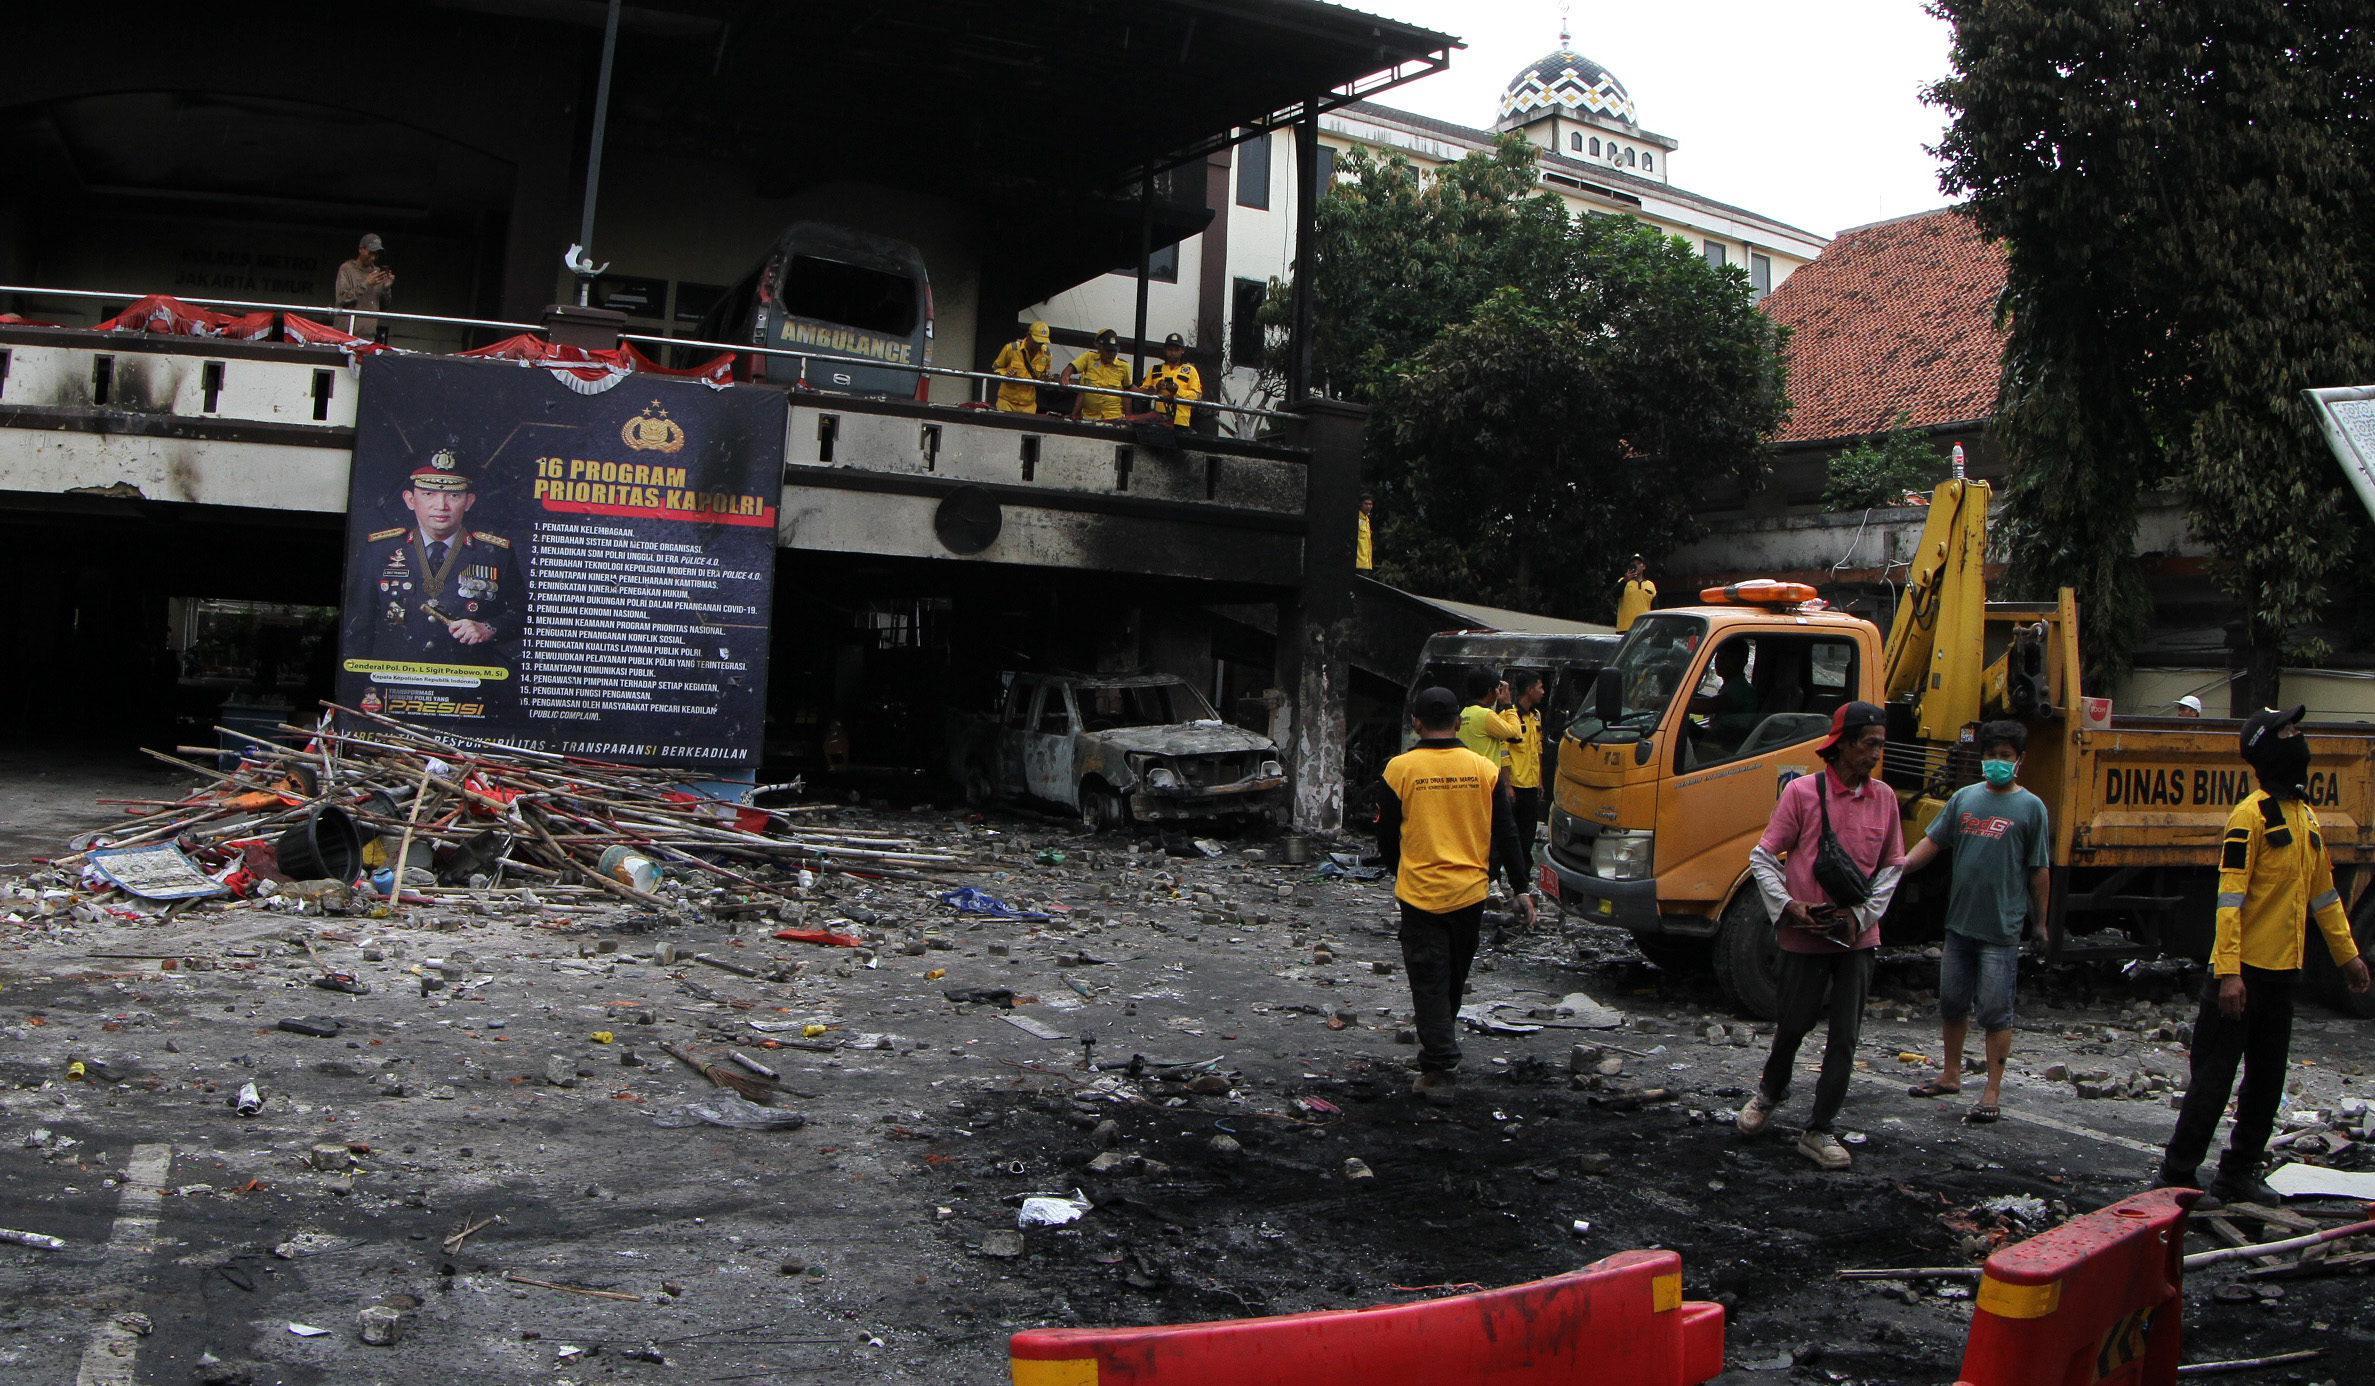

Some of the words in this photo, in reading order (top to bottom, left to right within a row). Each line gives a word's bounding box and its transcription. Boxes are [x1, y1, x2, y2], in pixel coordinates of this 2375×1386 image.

[181, 248, 251, 266] POLRES
[256, 254, 317, 271] METRO
[175, 271, 257, 291] JAKARTA
[263, 277, 314, 294] TIMUR
[780, 320, 912, 364] AMBULANCE
[535, 457, 564, 478] 16
[570, 459, 687, 488] PROGRAM
[534, 478, 660, 508] PRIORITAS
[665, 489, 764, 516] KAPOLRI
[534, 522, 541, 531] 1.
[542, 523, 579, 533] PENATAAN
[580, 525, 635, 537] KELEMBAGAAN.
[532, 534, 540, 542] 2.
[541, 534, 584, 545] PERUBAHAN
[585, 537, 612, 547] SISTEM
[613, 539, 628, 548] DAN
[629, 540, 658, 550] METODE
[659, 542, 703, 553] ORGANISASI.
[532, 545, 539, 554] 3.
[540, 546, 586, 557] MENJADIKAN
[587, 549, 603, 558] SDM
[604, 550, 625, 560] POLRI
[626, 551, 654, 562] UNGGUL
[656, 553, 664, 562] DI
[664, 554, 679, 563] ERA
[680, 554, 705, 565] POLICE
[706, 556, 720, 566] 4.0.
[531, 557, 538, 566] 4.
[539, 558, 582, 568] PERUBAHAN
[584, 560, 623, 571] TEKNOLOGI
[624, 563, 665, 574] KEPOLISIAN
[666, 565, 696, 576] MODERN
[698, 567, 705, 576] DI
[706, 568, 720, 577] ERA
[722, 569, 746, 579] POLICE
[747, 570, 761, 580] 4.0.
[530, 568, 537, 577] 5.
[538, 569, 586, 580] PEMANTAPAN
[618, 574, 673, 586] PEMELIHARAAN
[674, 577, 719, 589] KAMTIBMAS.
[529, 580, 536, 589] 6.
[538, 581, 586, 592] PENINGKATAN
[618, 586, 661, 596] PENEGAKAN
[662, 588, 690, 598] HUKUM.
[527, 604, 534, 612] 8.
[536, 604, 578, 615] PEMULIHAN
[579, 607, 612, 617] EKONOMI
[613, 608, 650, 619] NASIONAL.
[528, 592, 536, 601] 7.
[537, 592, 585, 604] PEMANTAPAN
[586, 595, 625, 606] DUKUNGAN
[626, 598, 647, 607] POLRI
[648, 599, 673, 609] DALAM
[674, 600, 721, 612] PENANGANAN
[722, 603, 758, 614] COVID-19.
[527, 616, 534, 624] 9.
[535, 616, 573, 626] MENJAMIN
[574, 618, 615, 628] KEAMANAN
[616, 620, 651, 630] PROGRAM
[652, 622, 688, 633] PRIORITAS
[689, 624, 726, 635] NASIONAL.
[523, 627, 535, 636] 10.
[536, 628, 577, 638] PENGUATAN
[578, 630, 626, 641] PENANGANAN
[628, 633, 658, 642] KONFLIK
[659, 634, 686, 644] SOSIAL.
[522, 639, 534, 648] 11.
[535, 640, 584, 650] PENINGKATAN
[585, 642, 619, 652] KUALITAS
[620, 644, 652, 654] LAYANAN
[654, 646, 679, 655] PUBLIK
[680, 647, 703, 656] POLRI.
[521, 651, 533, 659] 12.
[534, 651, 584, 662] MEWUJUDKAN
[585, 654, 626, 664] PELAYANAN
[628, 656, 653, 665] PUBLIK
[654, 657, 675, 666] POLRI
[676, 658, 695, 667] YANG
[697, 659, 747, 670] TERINTEGRASI.
[521, 662, 532, 671] 13.
[534, 663, 581, 673] PEMANTAPAN
[583, 665, 627, 675] KOMUNIKASI
[628, 668, 657, 677] PUBLIK.
[446, 668, 482, 676] Prabowo,
[520, 674, 532, 683] 14.
[583, 677, 618, 687] PIMPINAN
[620, 679, 657, 689] TERHADAP
[658, 680, 682, 690] SETIAP
[684, 682, 720, 692] KEGIATAN.
[520, 686, 531, 694] 15.
[532, 686, 574, 696] PENGUATAN
[575, 688, 601, 697] FUNGSI
[602, 690, 652, 700] PENGAWASAN.
[388, 700, 485, 716] PRESISI
[529, 709, 559, 719] (PUBLIC
[559, 710, 601, 720] COMPLAIN).
[532, 698, 580, 708] PENGAWASAN
[582, 700, 600, 709] OLEH
[601, 701, 648, 711] MASYARAKAT
[650, 703, 680, 712] PENCARI
[681, 704, 718, 714] KEADILAN
[562, 741, 658, 756] TRANSPARANSI
[661, 746, 748, 759] BERKEADILAN
[2106, 768, 2184, 805] DINAS
[2192, 770, 2250, 805] BINA
